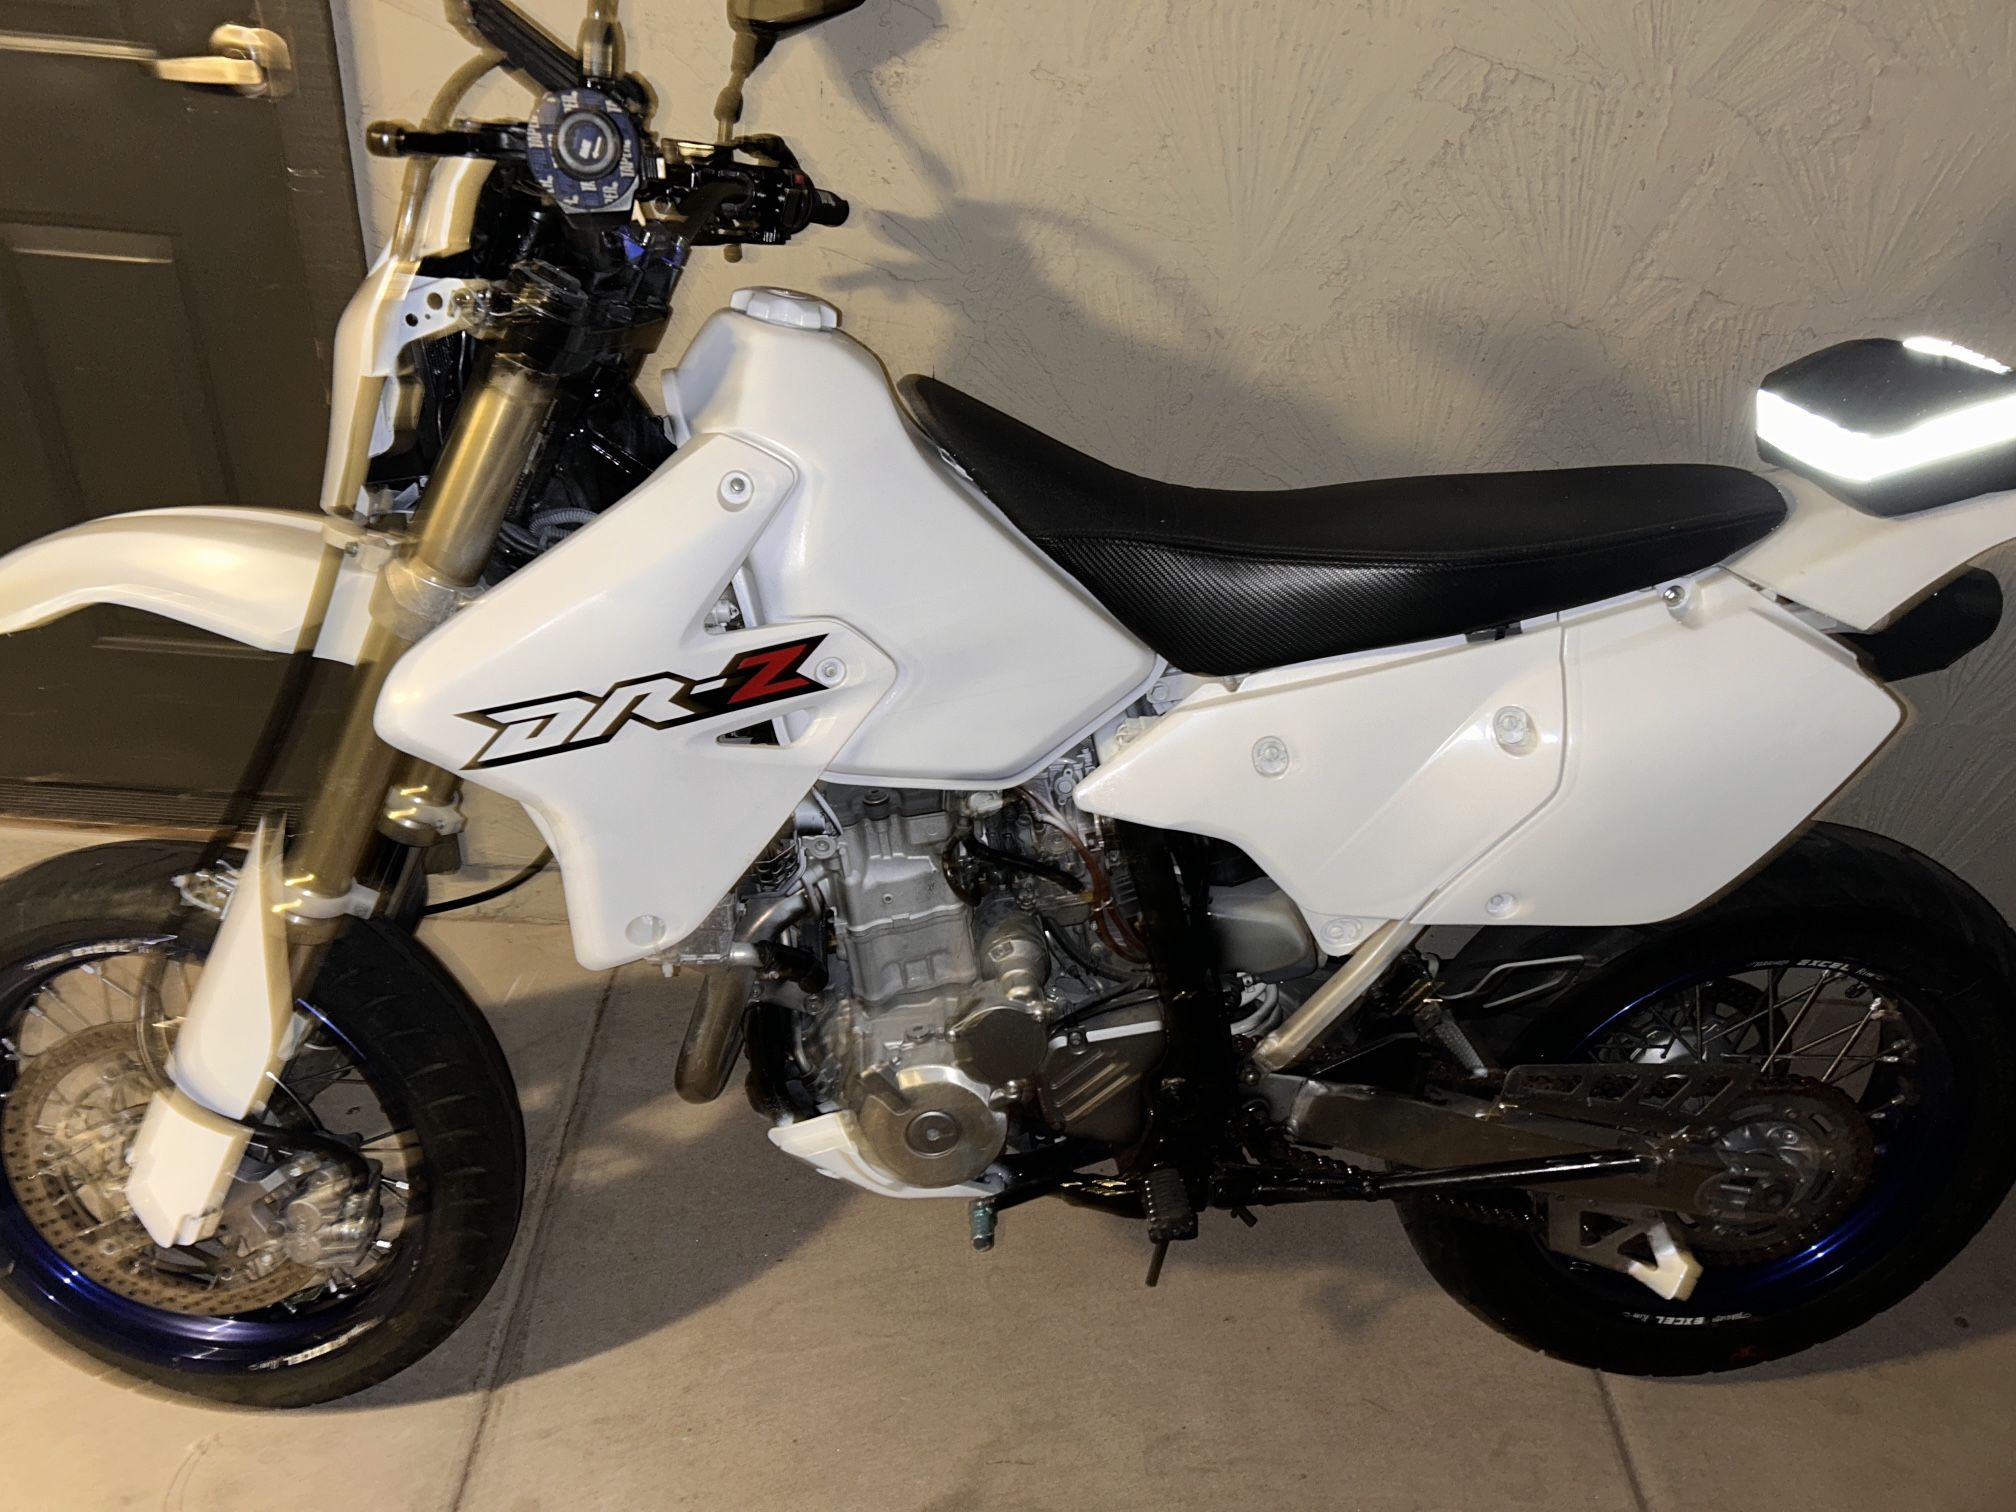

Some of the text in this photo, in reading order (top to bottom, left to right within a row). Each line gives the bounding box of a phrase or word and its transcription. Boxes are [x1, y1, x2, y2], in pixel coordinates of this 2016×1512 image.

[453, 633, 830, 770] DR-Z
[1796, 959, 1850, 973] EXCEL
[1656, 1316, 1705, 1325] EXCEL
